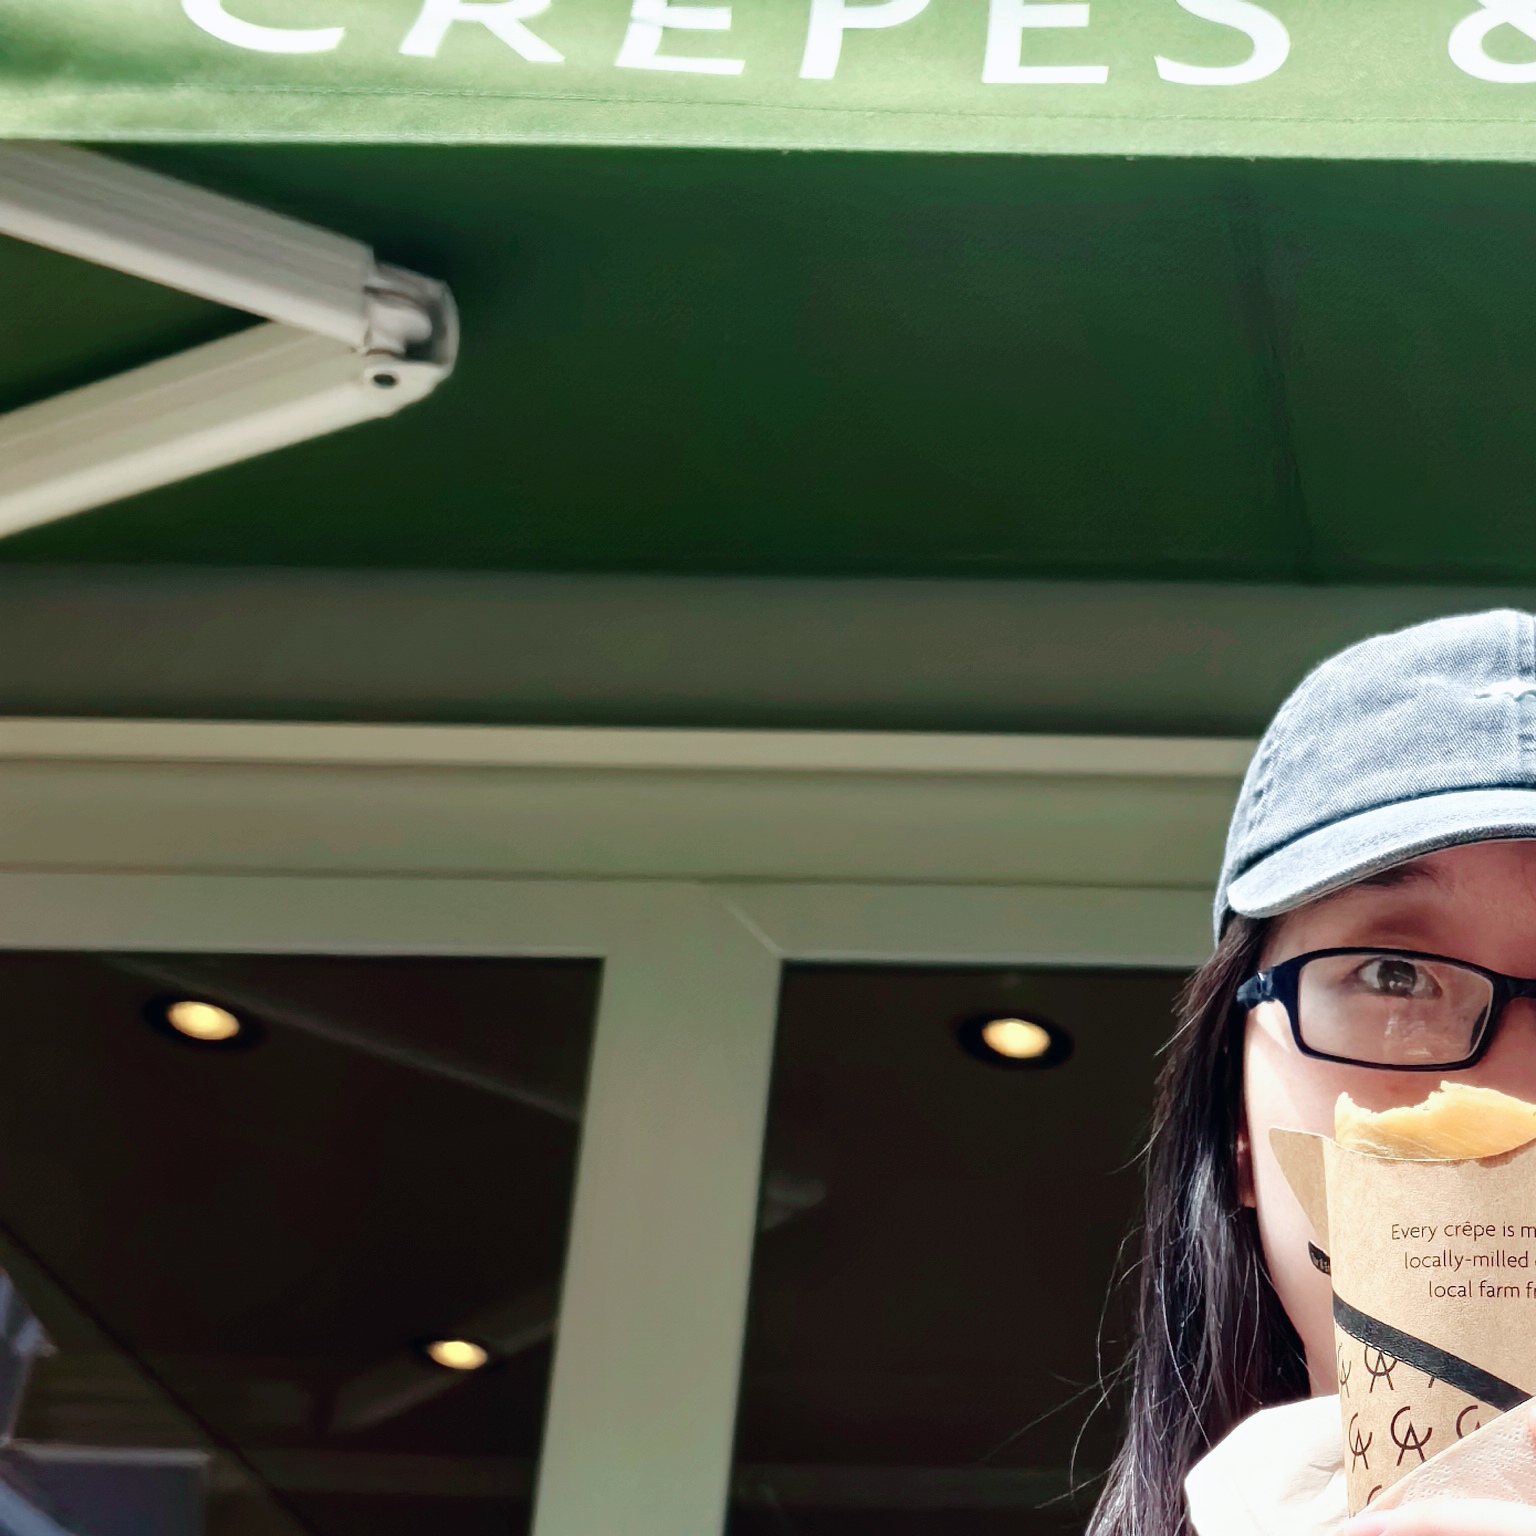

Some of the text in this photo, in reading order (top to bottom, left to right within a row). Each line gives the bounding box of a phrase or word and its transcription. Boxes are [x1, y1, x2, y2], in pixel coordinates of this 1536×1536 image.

[1391, 1222, 1438, 1242] Every
[1443, 1221, 1496, 1243] crêpe
[1502, 1222, 1515, 1238] is
[1404, 1250, 1529, 1272] locally-milled
[1428, 1280, 1473, 1298] local
[1478, 1280, 1521, 1298] farm
